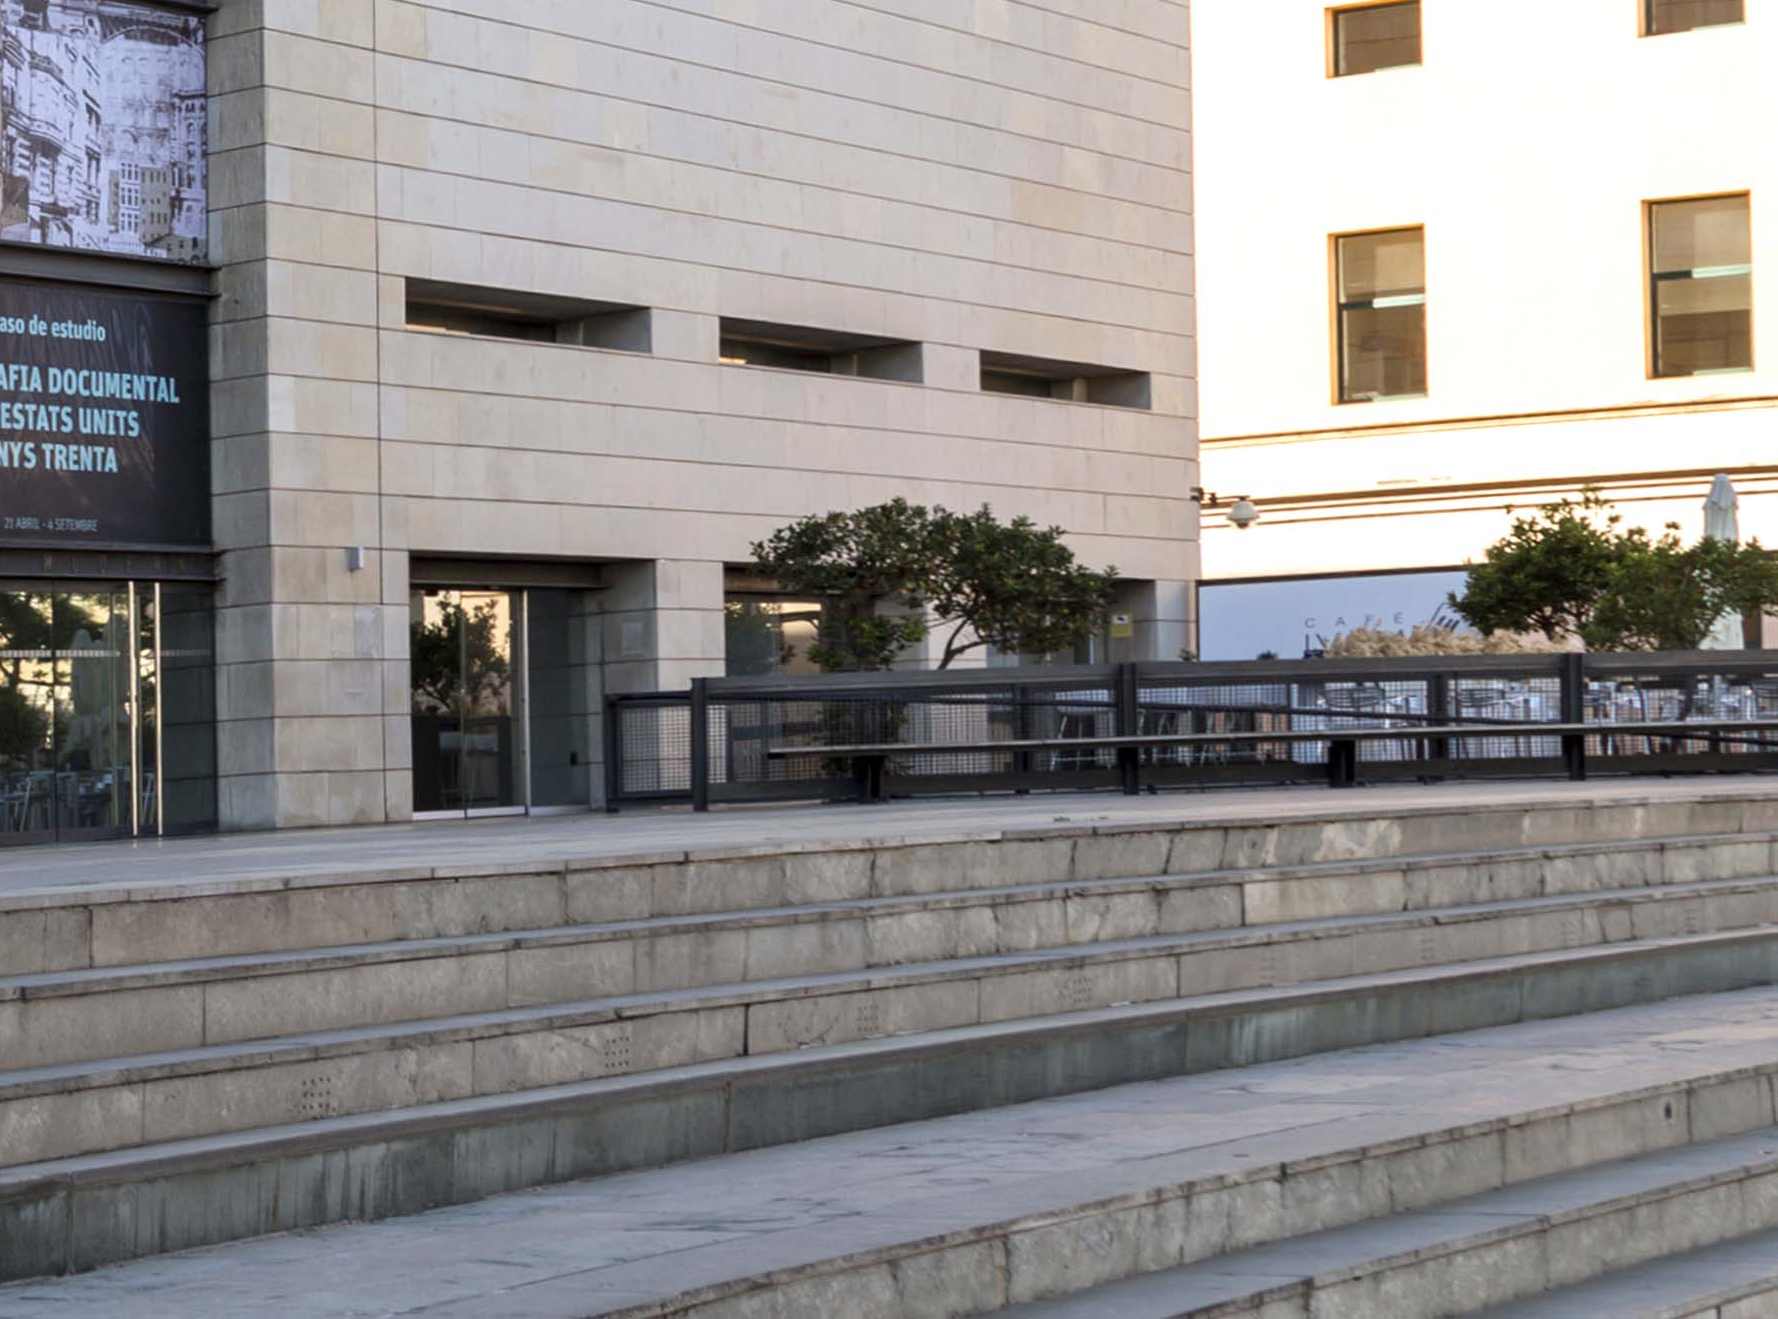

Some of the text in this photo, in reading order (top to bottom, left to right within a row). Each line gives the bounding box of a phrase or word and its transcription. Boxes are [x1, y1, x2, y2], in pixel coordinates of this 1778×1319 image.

[28, 314, 47, 335] de
[51, 319, 106, 341] estudio
[47, 367, 180, 403] DOCUMENTAL
[0, 402, 73, 433] ESTATS
[78, 408, 140, 437] UNITS
[42, 442, 118, 473] TRENTA
